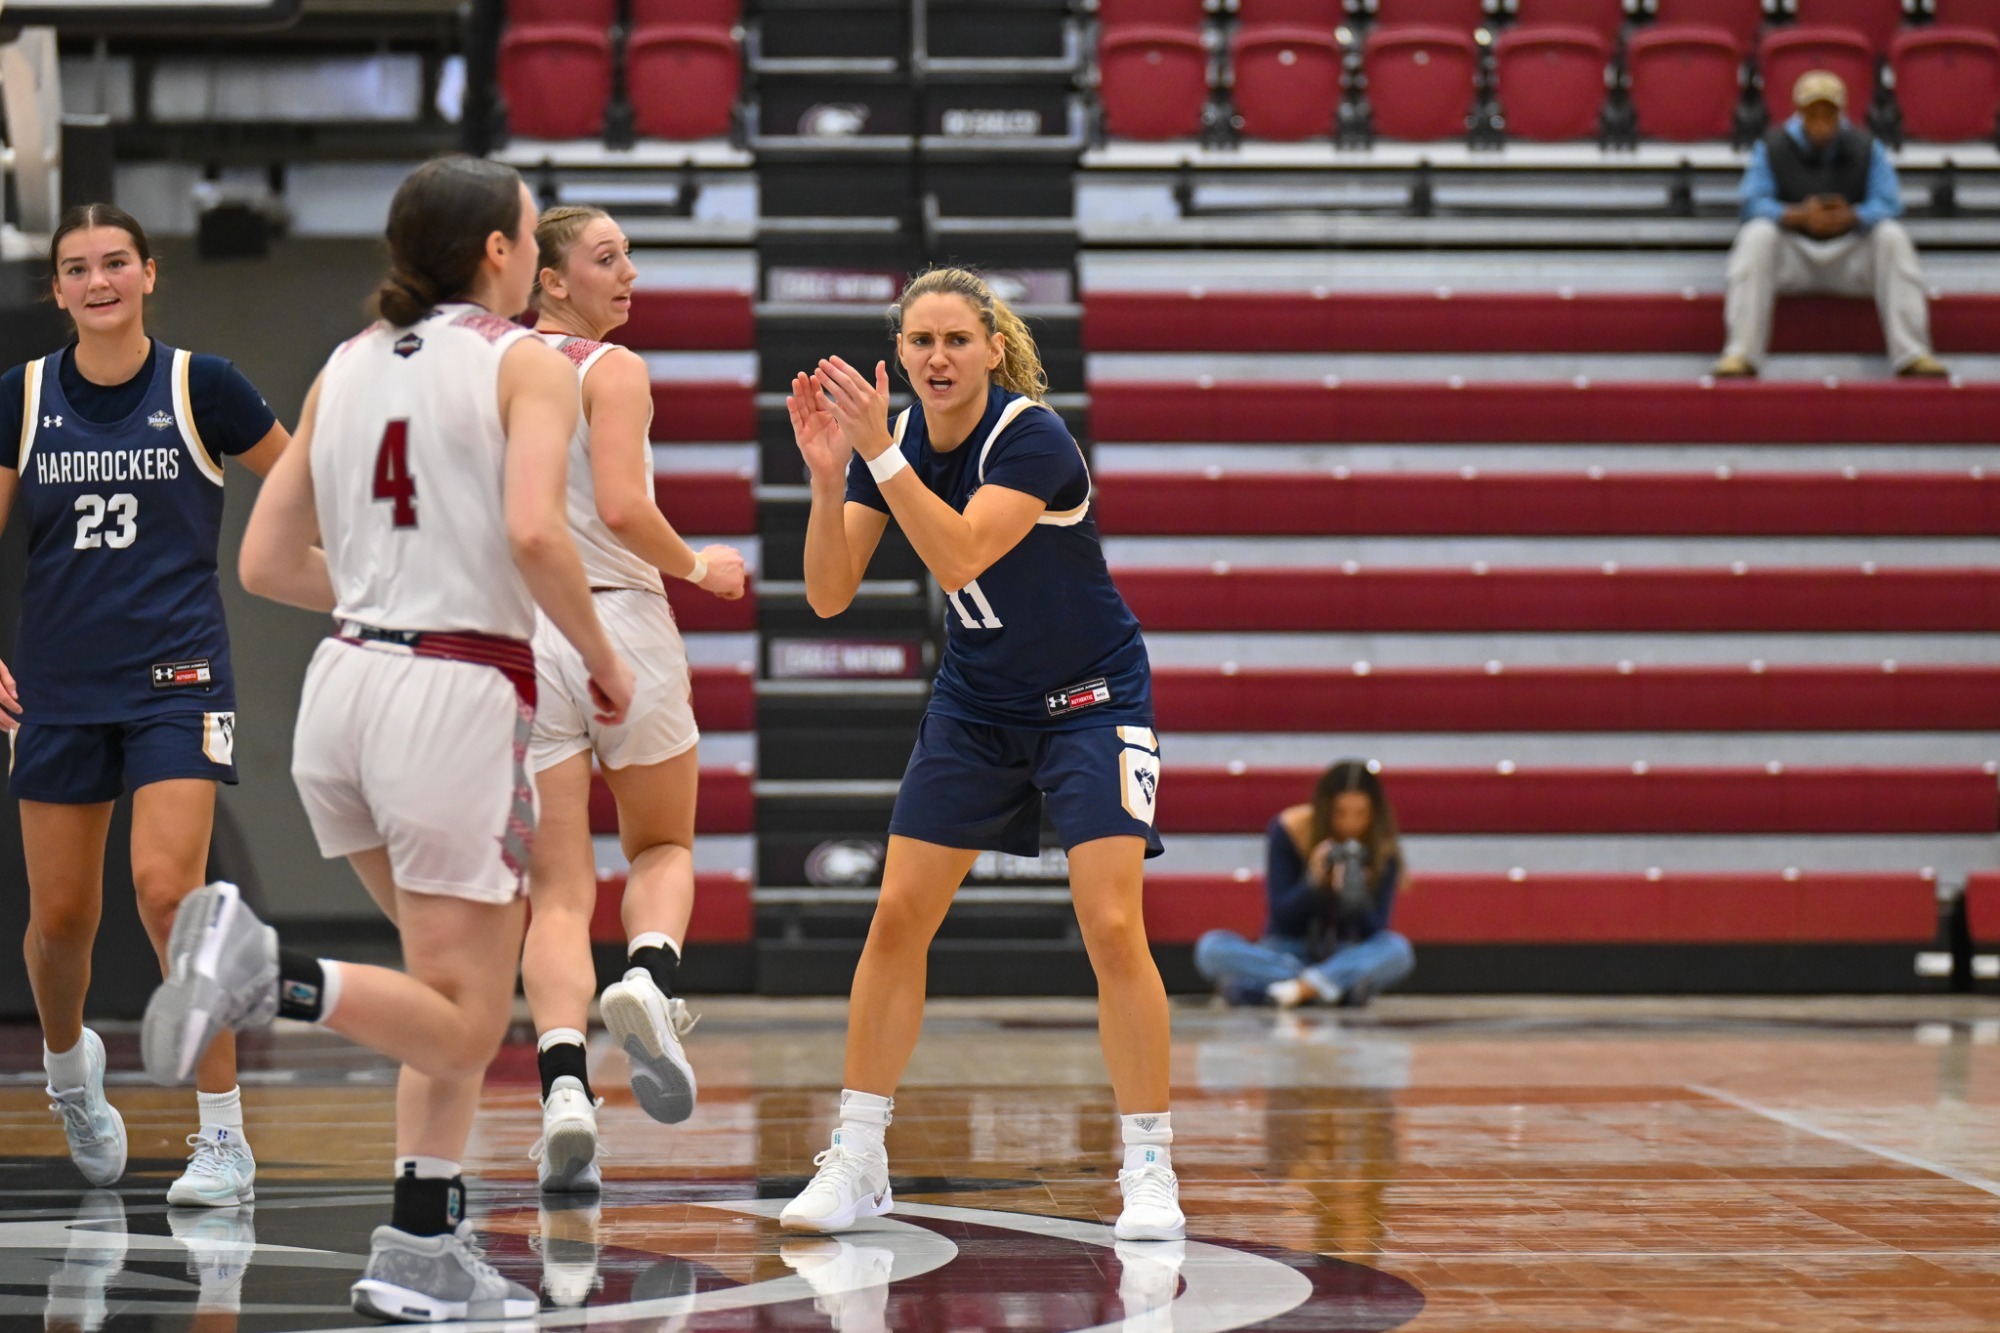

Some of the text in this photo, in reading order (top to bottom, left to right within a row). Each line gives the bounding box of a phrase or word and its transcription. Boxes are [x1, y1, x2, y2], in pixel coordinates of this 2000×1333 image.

[148, 416, 173, 425] RMAC
[36, 448, 180, 484] HARDROCKERS
[371, 417, 419, 530] 4
[73, 493, 138, 549] 23
[946, 579, 1004, 629] 11
